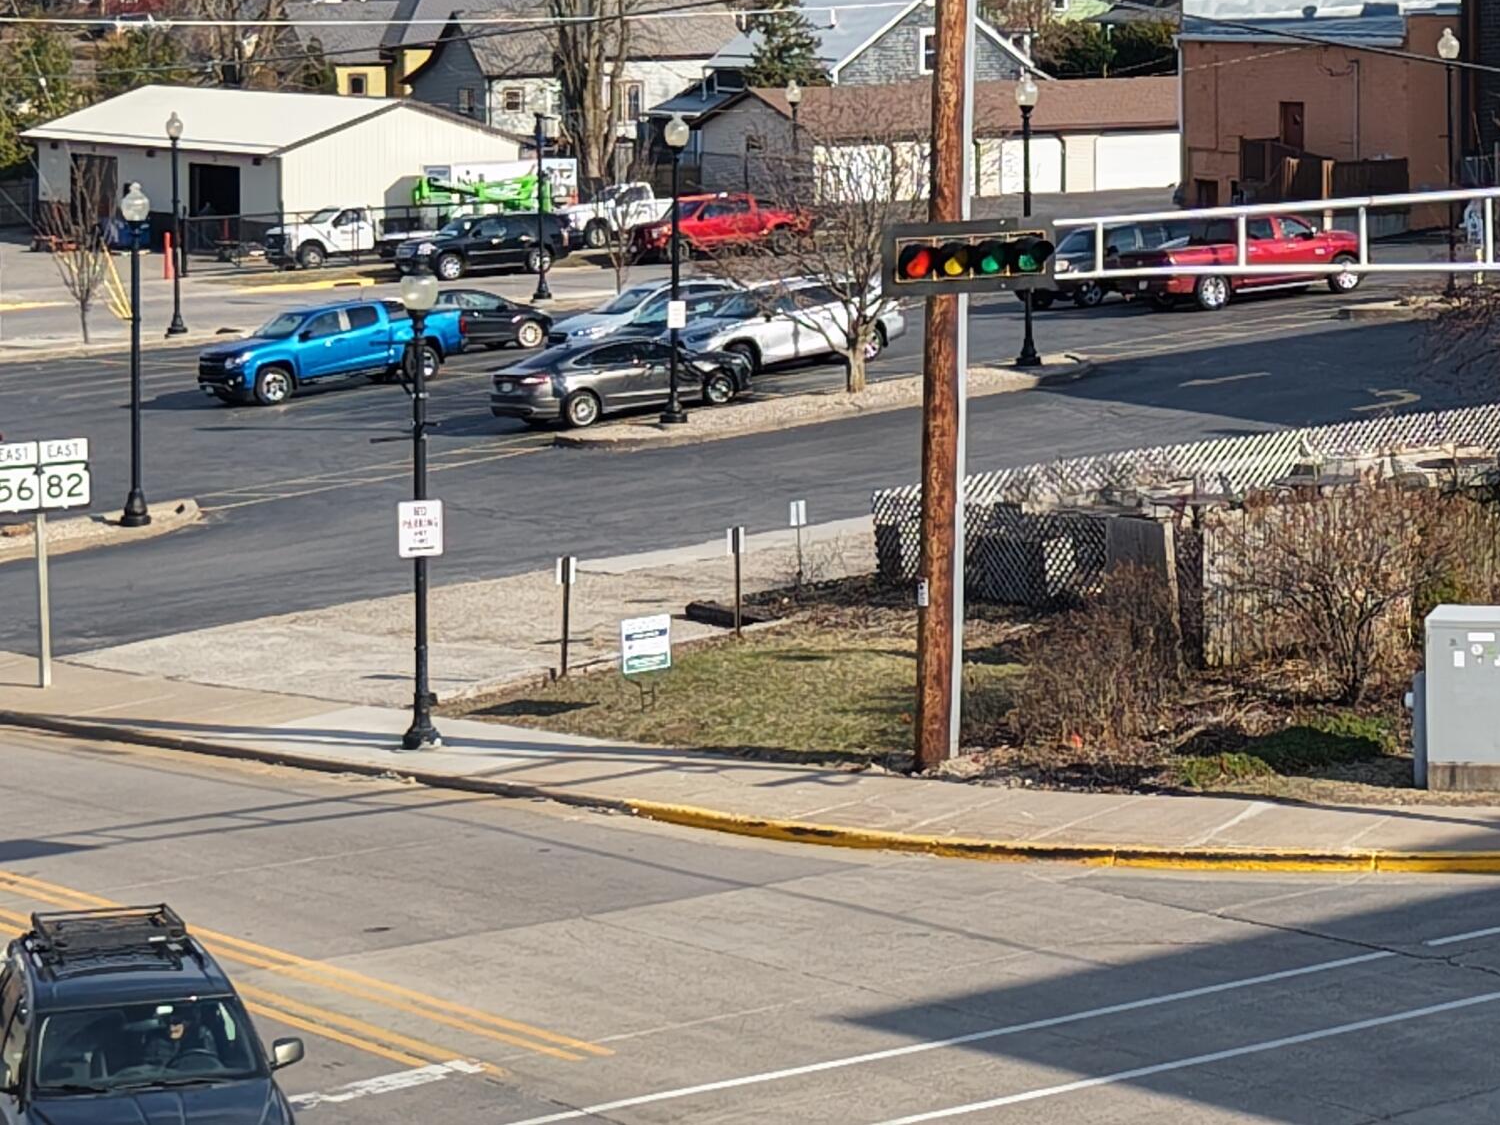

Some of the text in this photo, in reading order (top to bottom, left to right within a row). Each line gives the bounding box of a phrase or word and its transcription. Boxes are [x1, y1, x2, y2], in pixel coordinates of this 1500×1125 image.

[0, 447, 28, 462] EAST
[47, 442, 79, 458] EAST
[0, 478, 34, 502] 56
[46, 473, 83, 498] 82
